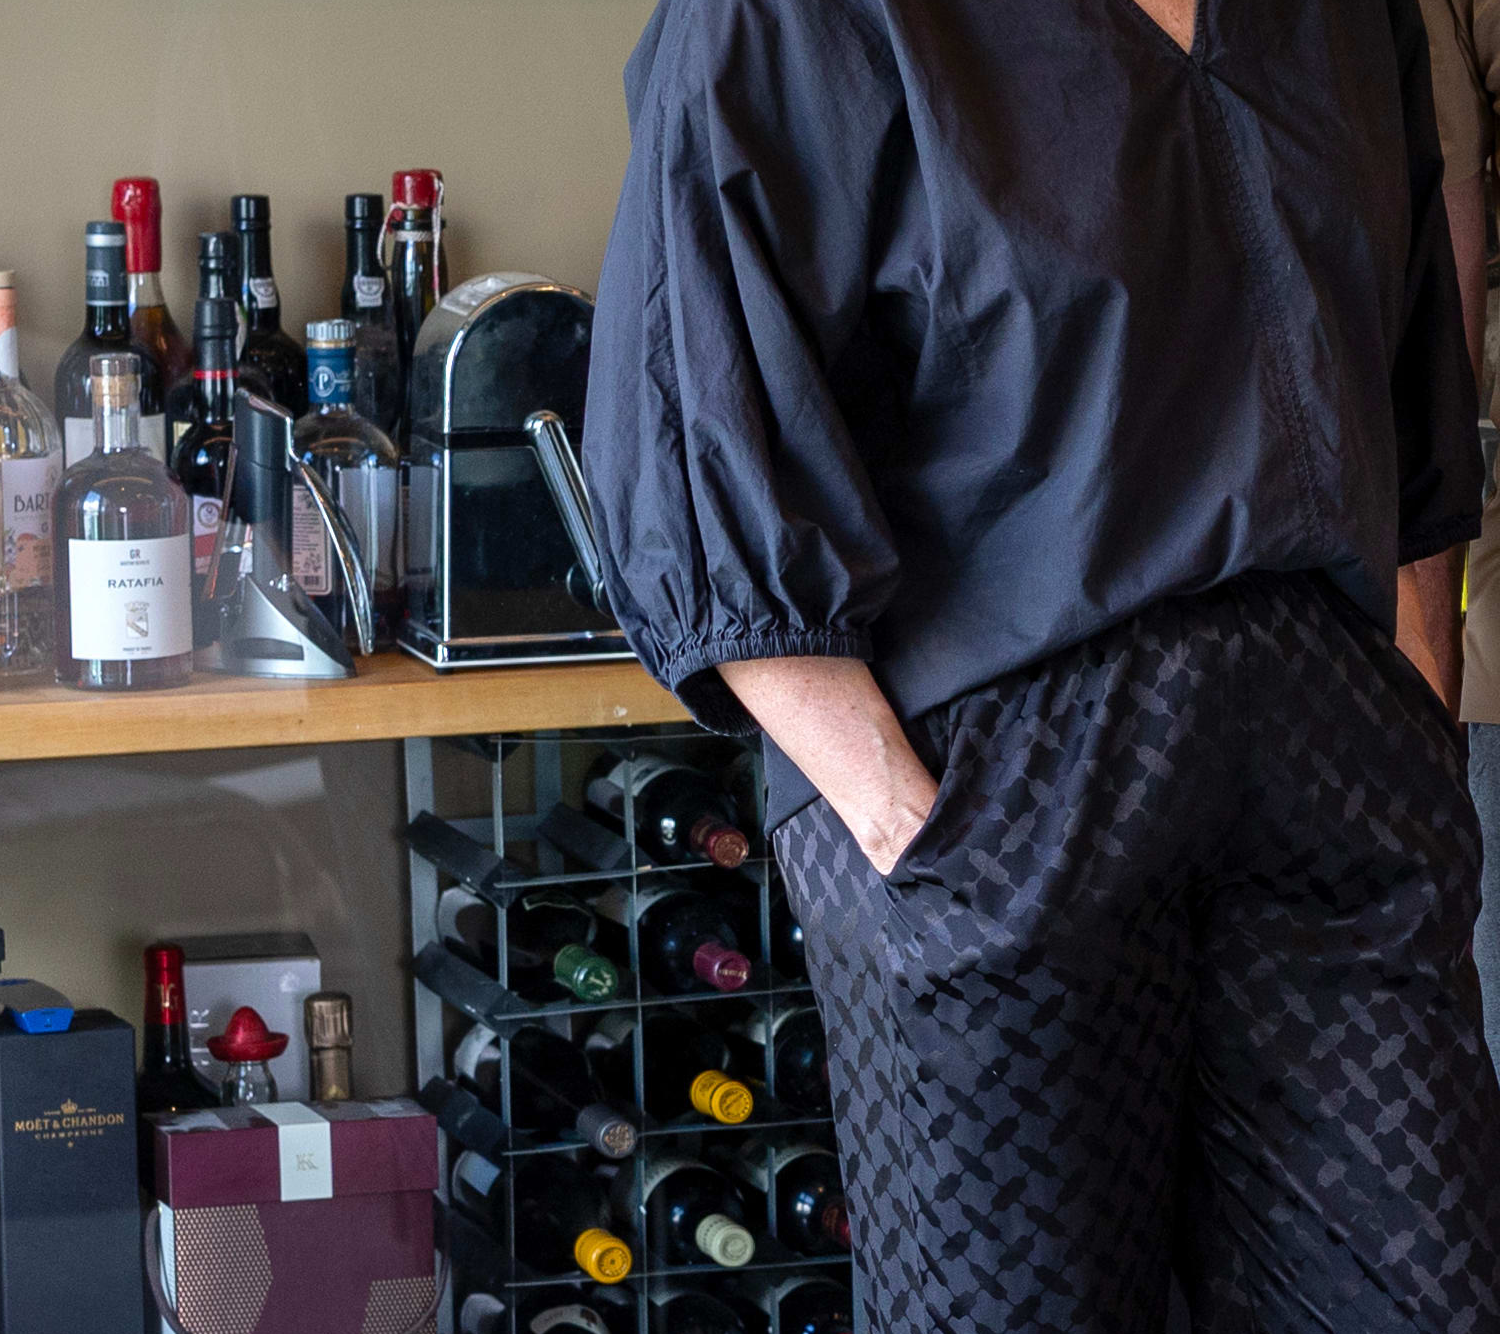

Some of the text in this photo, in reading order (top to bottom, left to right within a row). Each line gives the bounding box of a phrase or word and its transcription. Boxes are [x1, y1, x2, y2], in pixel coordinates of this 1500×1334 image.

[107, 576, 165, 590] RATAFIA
[61, 1113, 125, 1129] CHANDON
[34, 1128, 104, 1140] CHAMPAGNE
